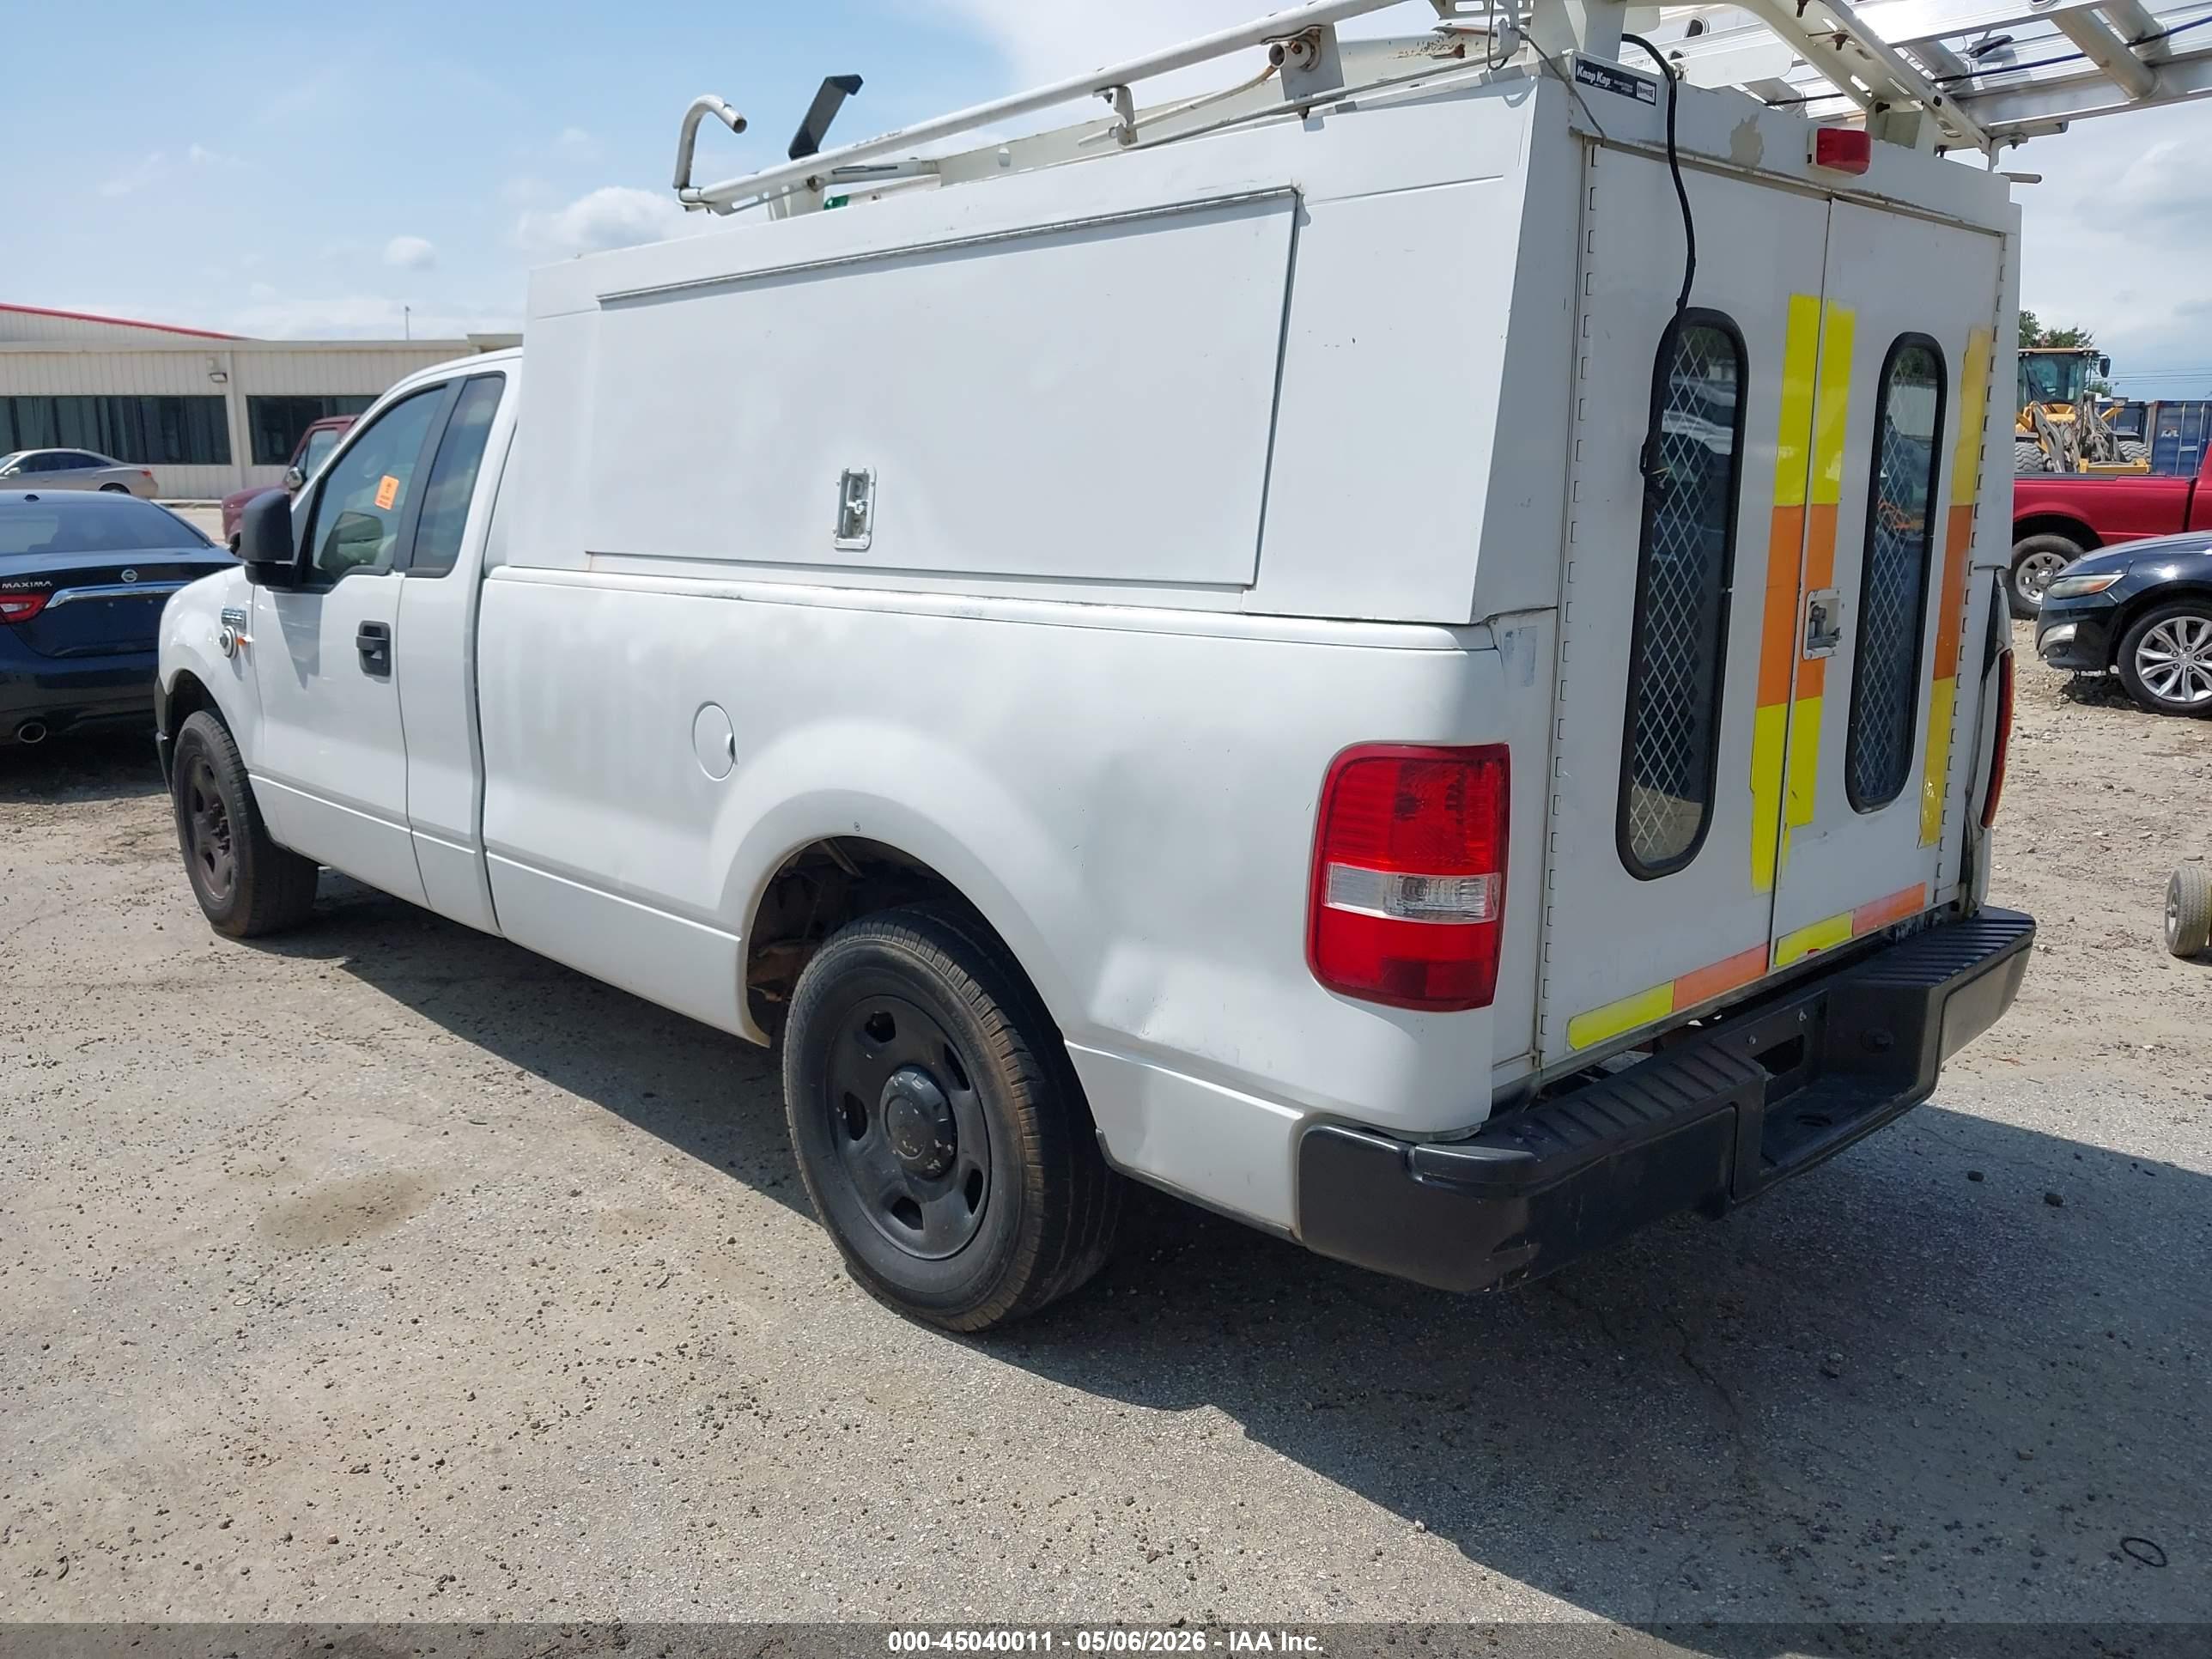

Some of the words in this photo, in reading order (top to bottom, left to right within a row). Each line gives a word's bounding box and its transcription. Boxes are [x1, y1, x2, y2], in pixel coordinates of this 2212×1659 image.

[1577, 65, 1595, 83] Knap
[1596, 71, 1611, 88] Kap
[2, 580, 52, 589] MAXIMA
